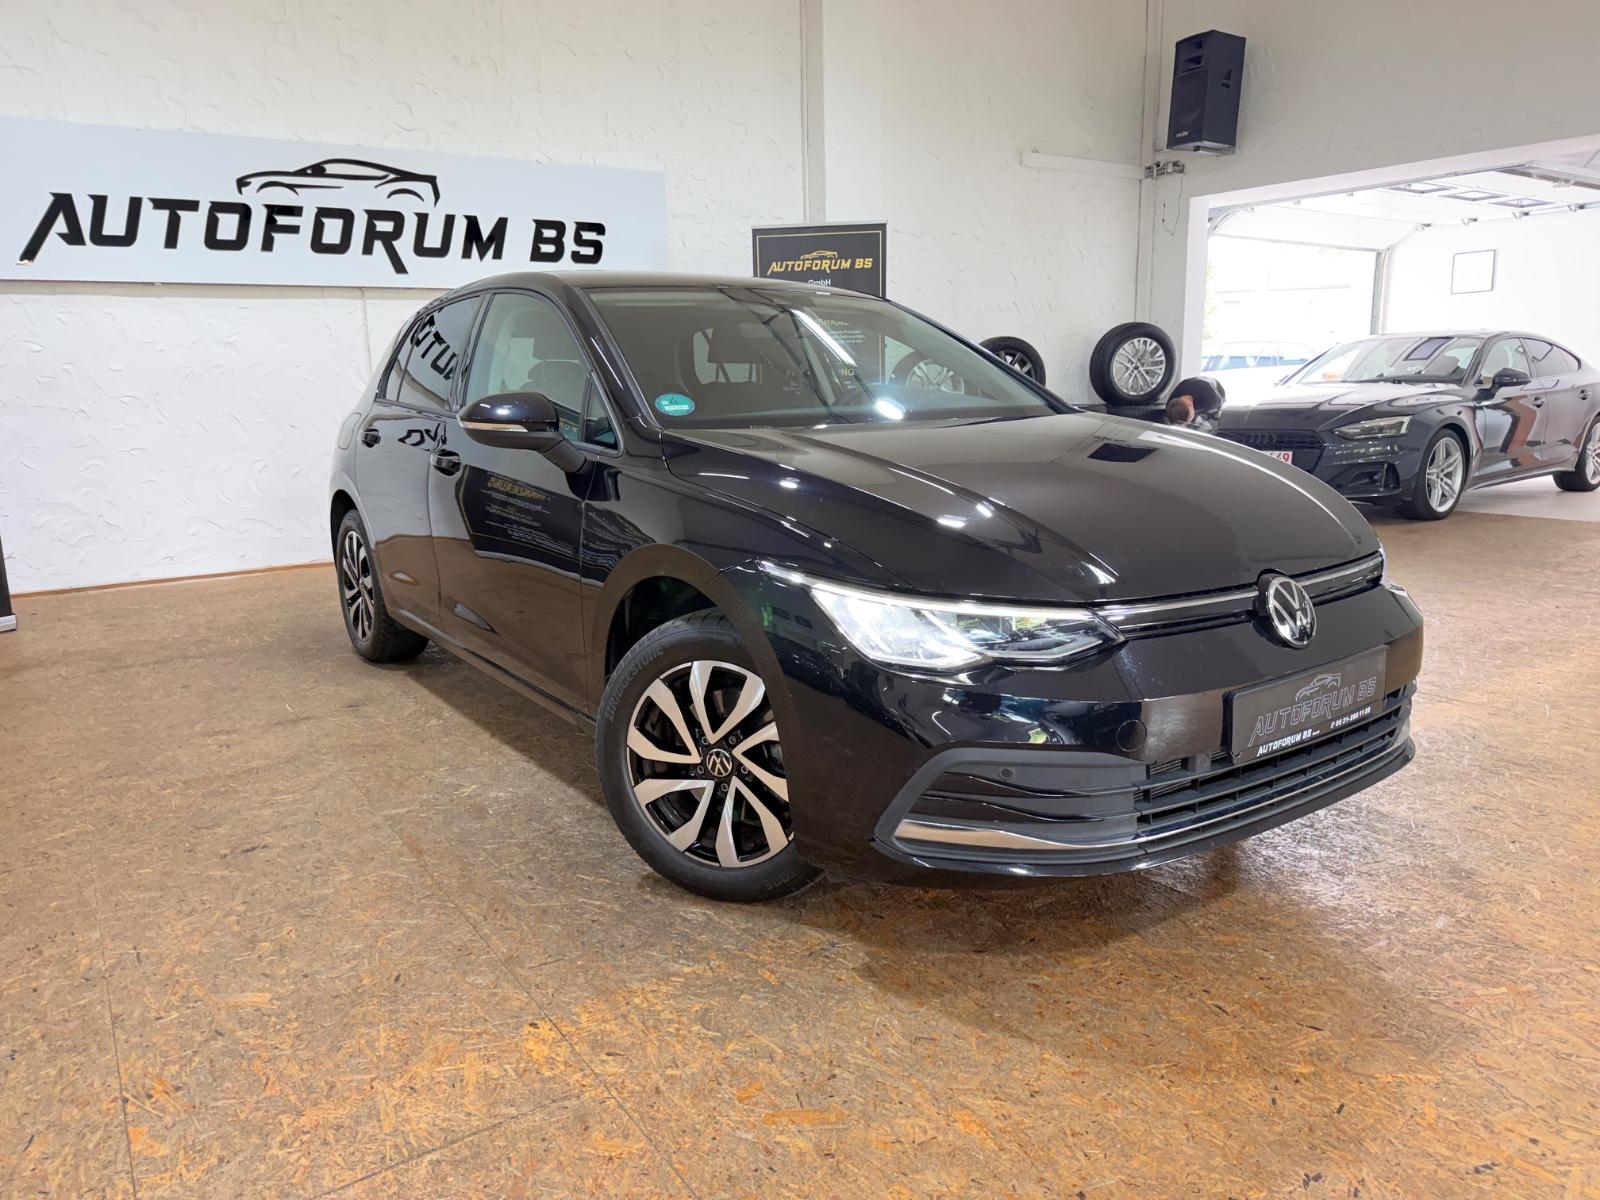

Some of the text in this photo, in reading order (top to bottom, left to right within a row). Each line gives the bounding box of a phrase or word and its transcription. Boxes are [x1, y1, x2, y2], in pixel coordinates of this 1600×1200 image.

[16, 192, 607, 275] AUTOFORUM BS
[767, 257, 873, 276] AUTOFORUM BS
[1247, 676, 1377, 747] AUTOFORUM BS
[1256, 731, 1302, 757] AUTOFORUM
